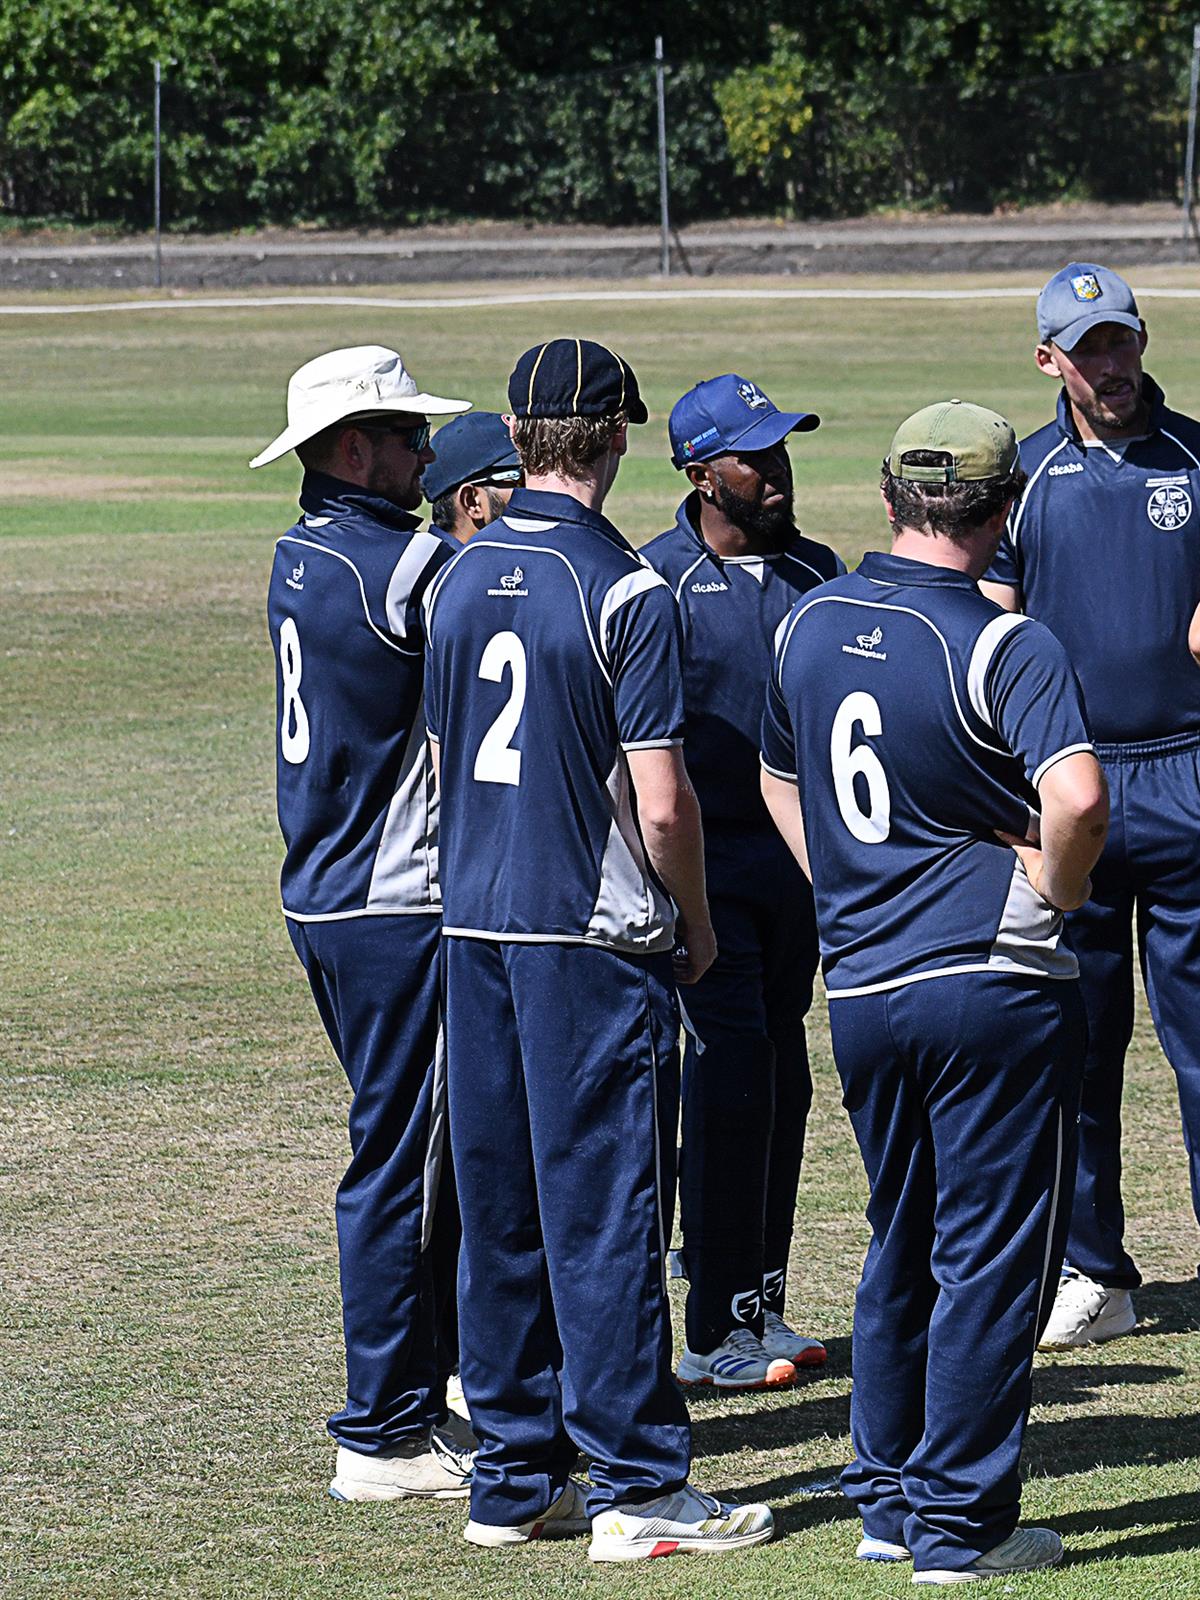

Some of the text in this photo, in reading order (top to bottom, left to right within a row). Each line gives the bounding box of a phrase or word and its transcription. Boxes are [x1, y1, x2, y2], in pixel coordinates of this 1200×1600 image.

[279, 617, 311, 764] 8
[473, 631, 527, 786] 2
[830, 691, 891, 844] 6
